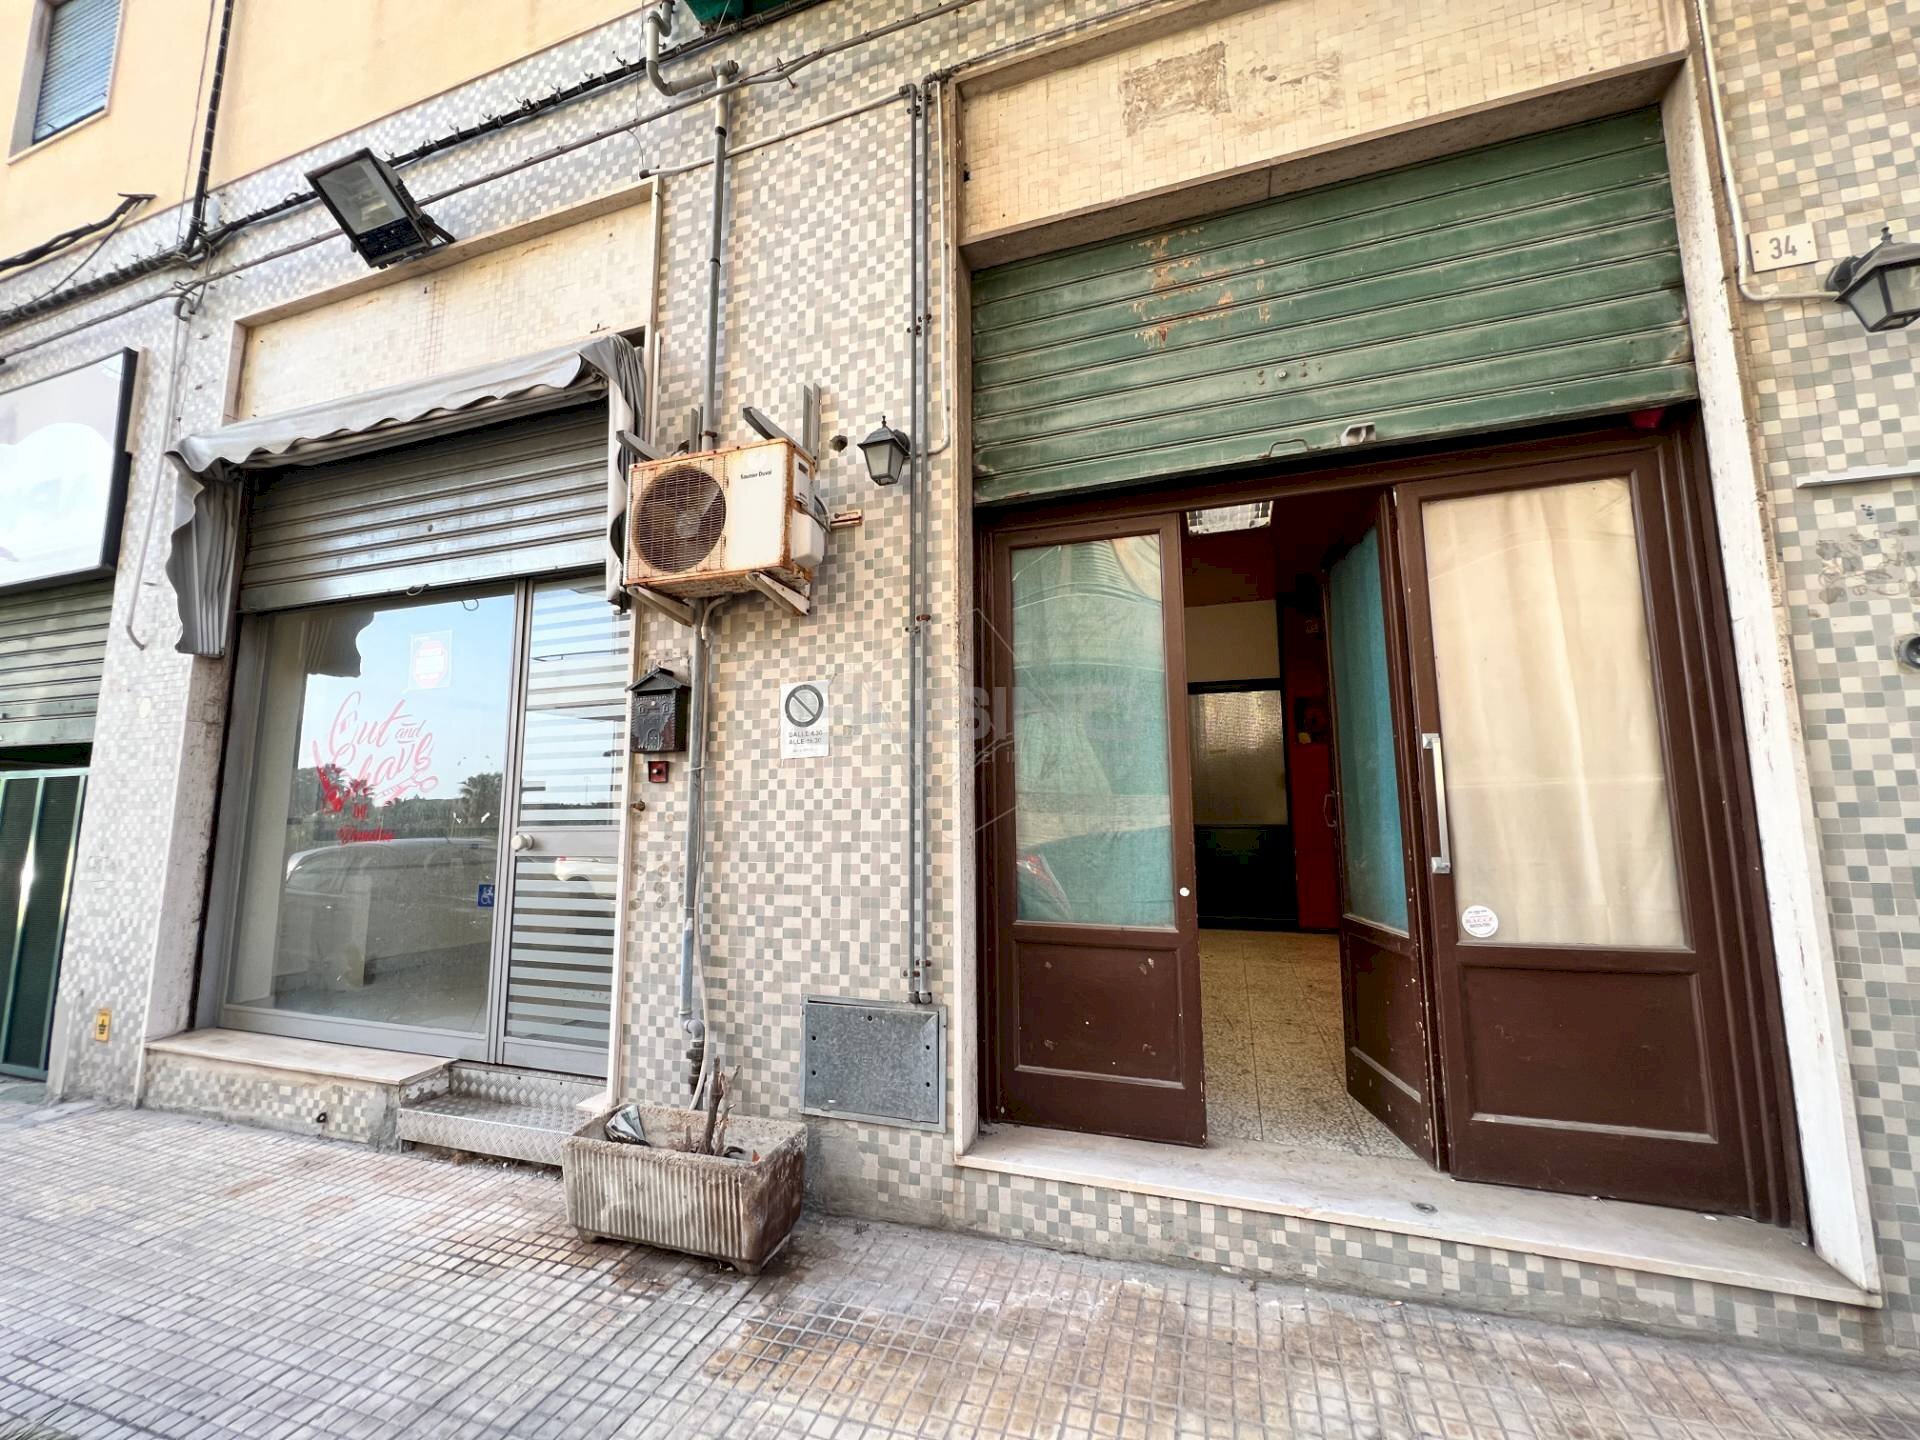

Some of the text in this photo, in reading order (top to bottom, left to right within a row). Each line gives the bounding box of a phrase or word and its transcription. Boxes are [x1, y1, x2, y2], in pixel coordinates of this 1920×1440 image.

[1769, 235, 1797, 260] 34
[328, 690, 413, 757] Cut
[394, 719, 427, 741] and
